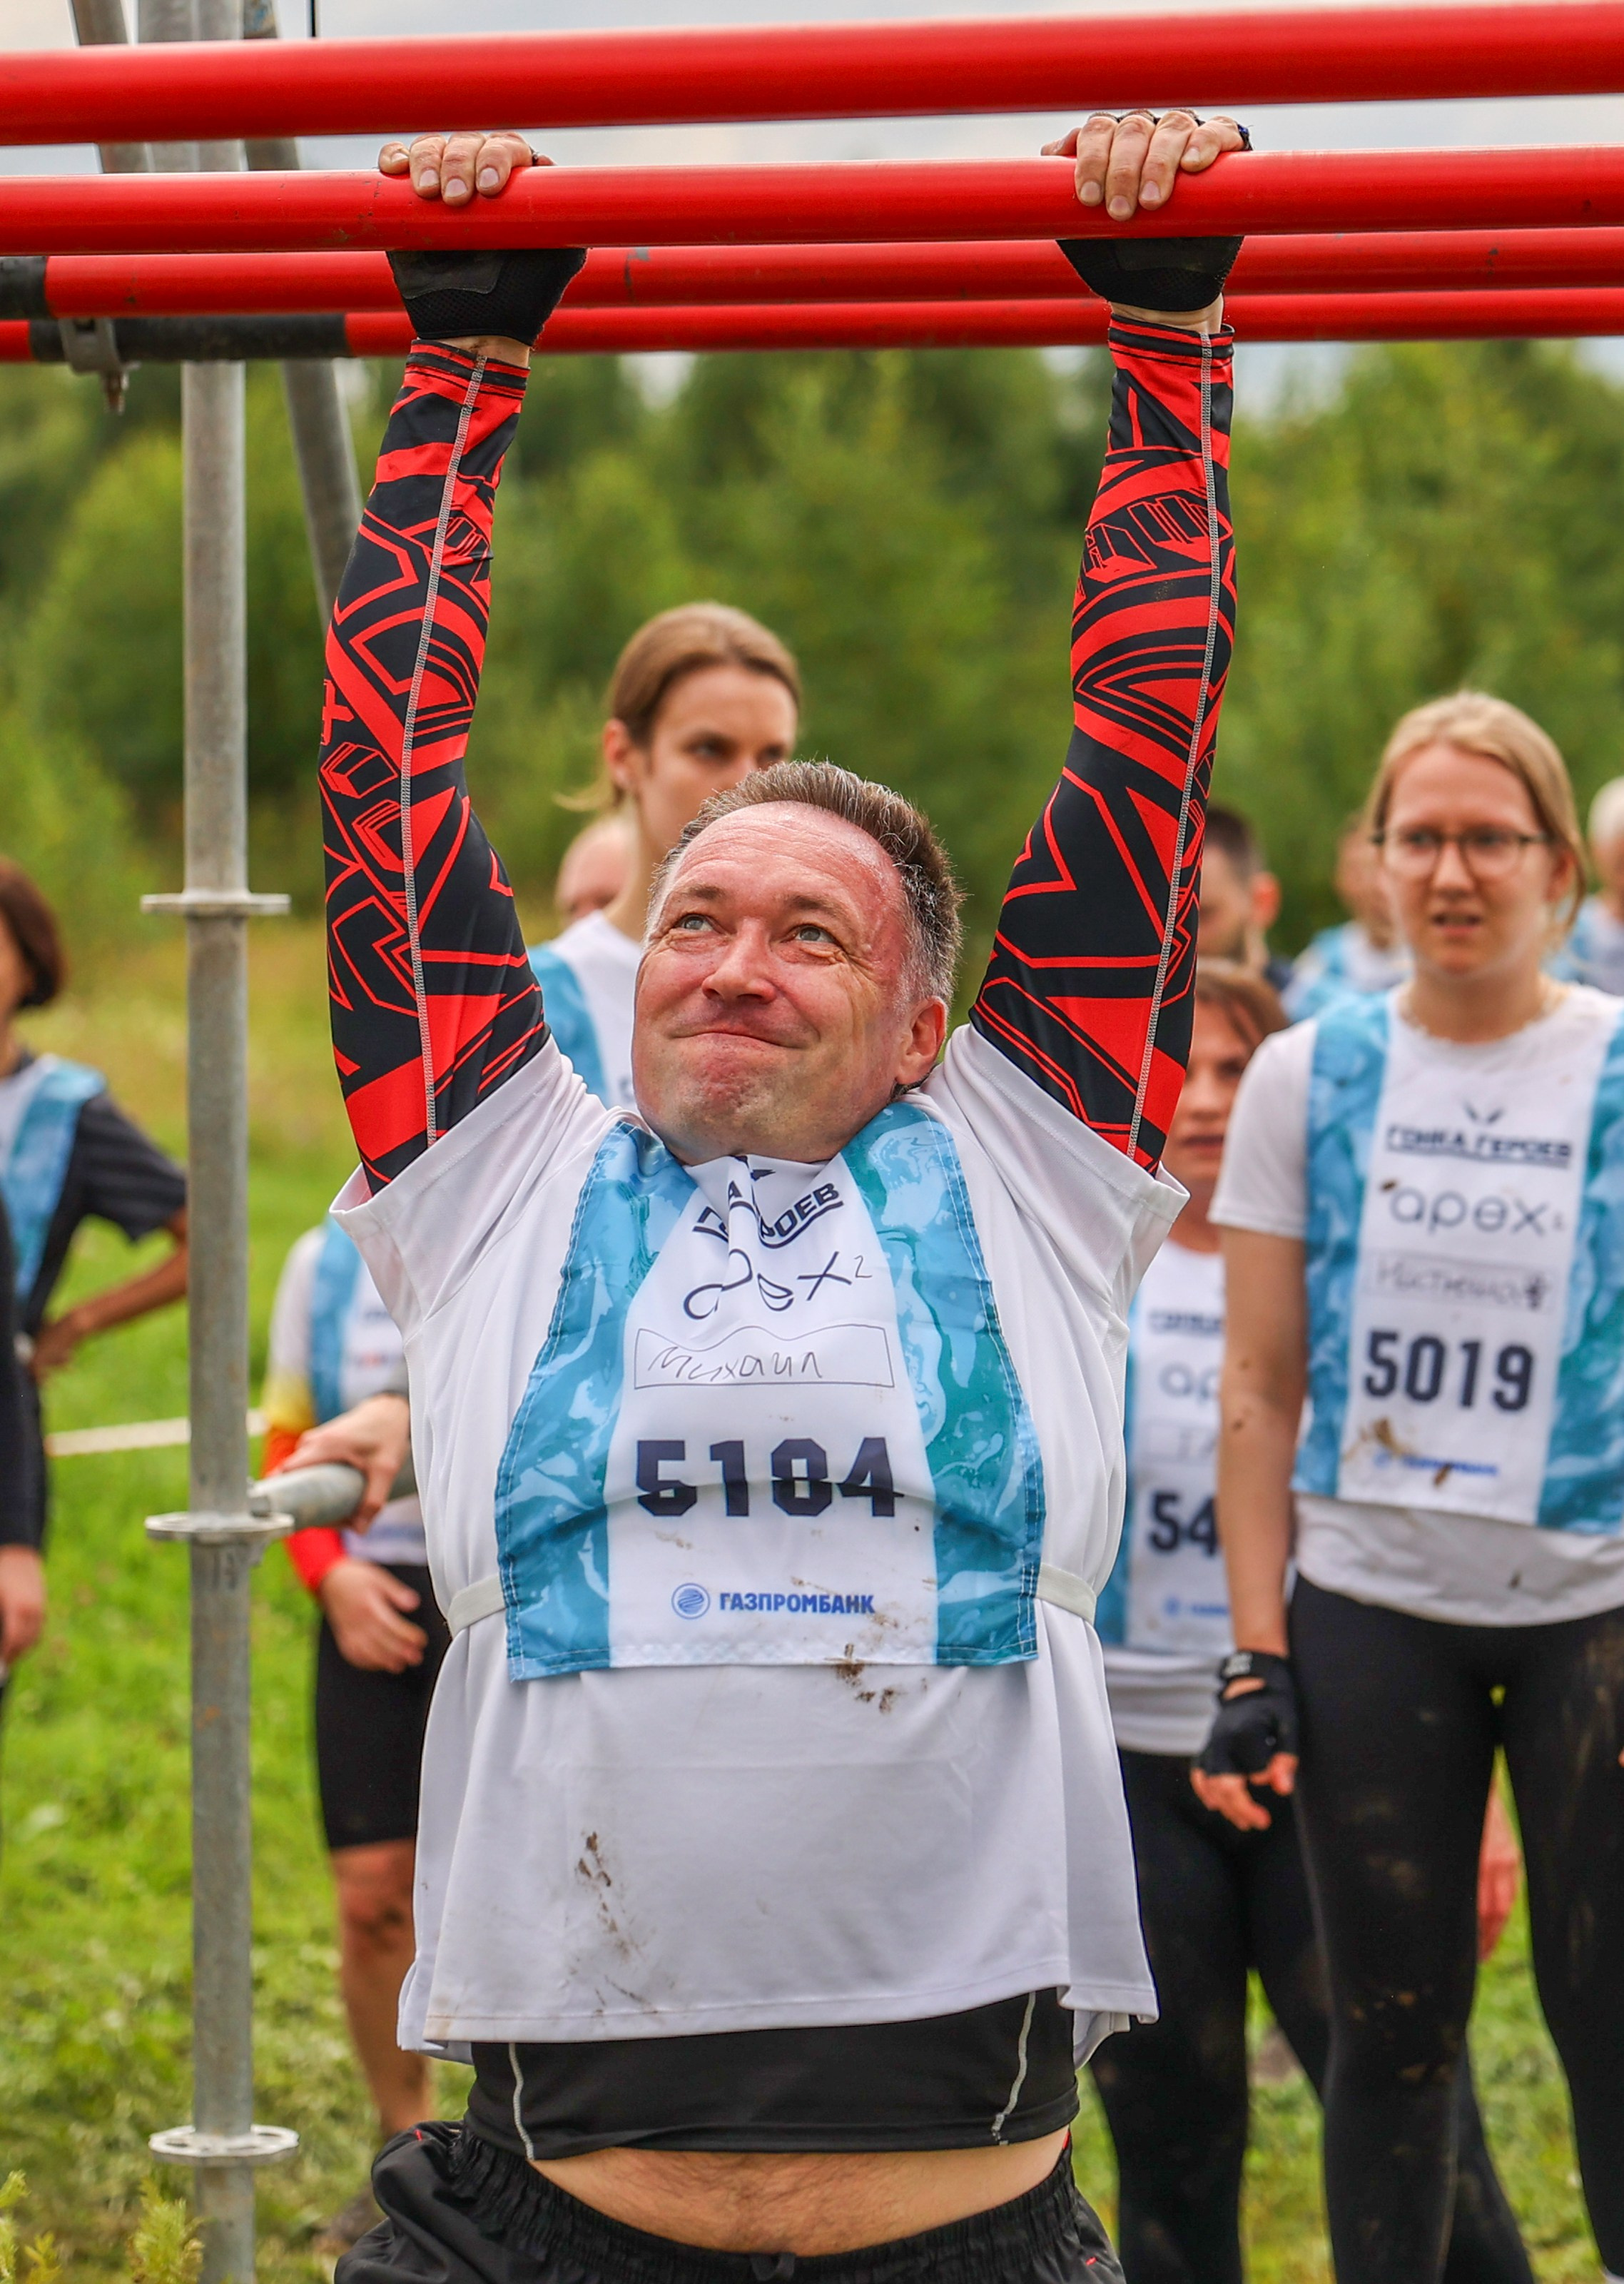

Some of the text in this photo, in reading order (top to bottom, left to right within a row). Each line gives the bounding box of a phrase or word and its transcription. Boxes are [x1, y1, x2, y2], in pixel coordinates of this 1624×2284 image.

[1364, 1330, 1534, 1412] 5019
[636, 1437, 905, 1517] 5184
[1150, 1491, 1217, 1556] 54
[719, 1592, 876, 1614] ГАЗПРОМБАНК
